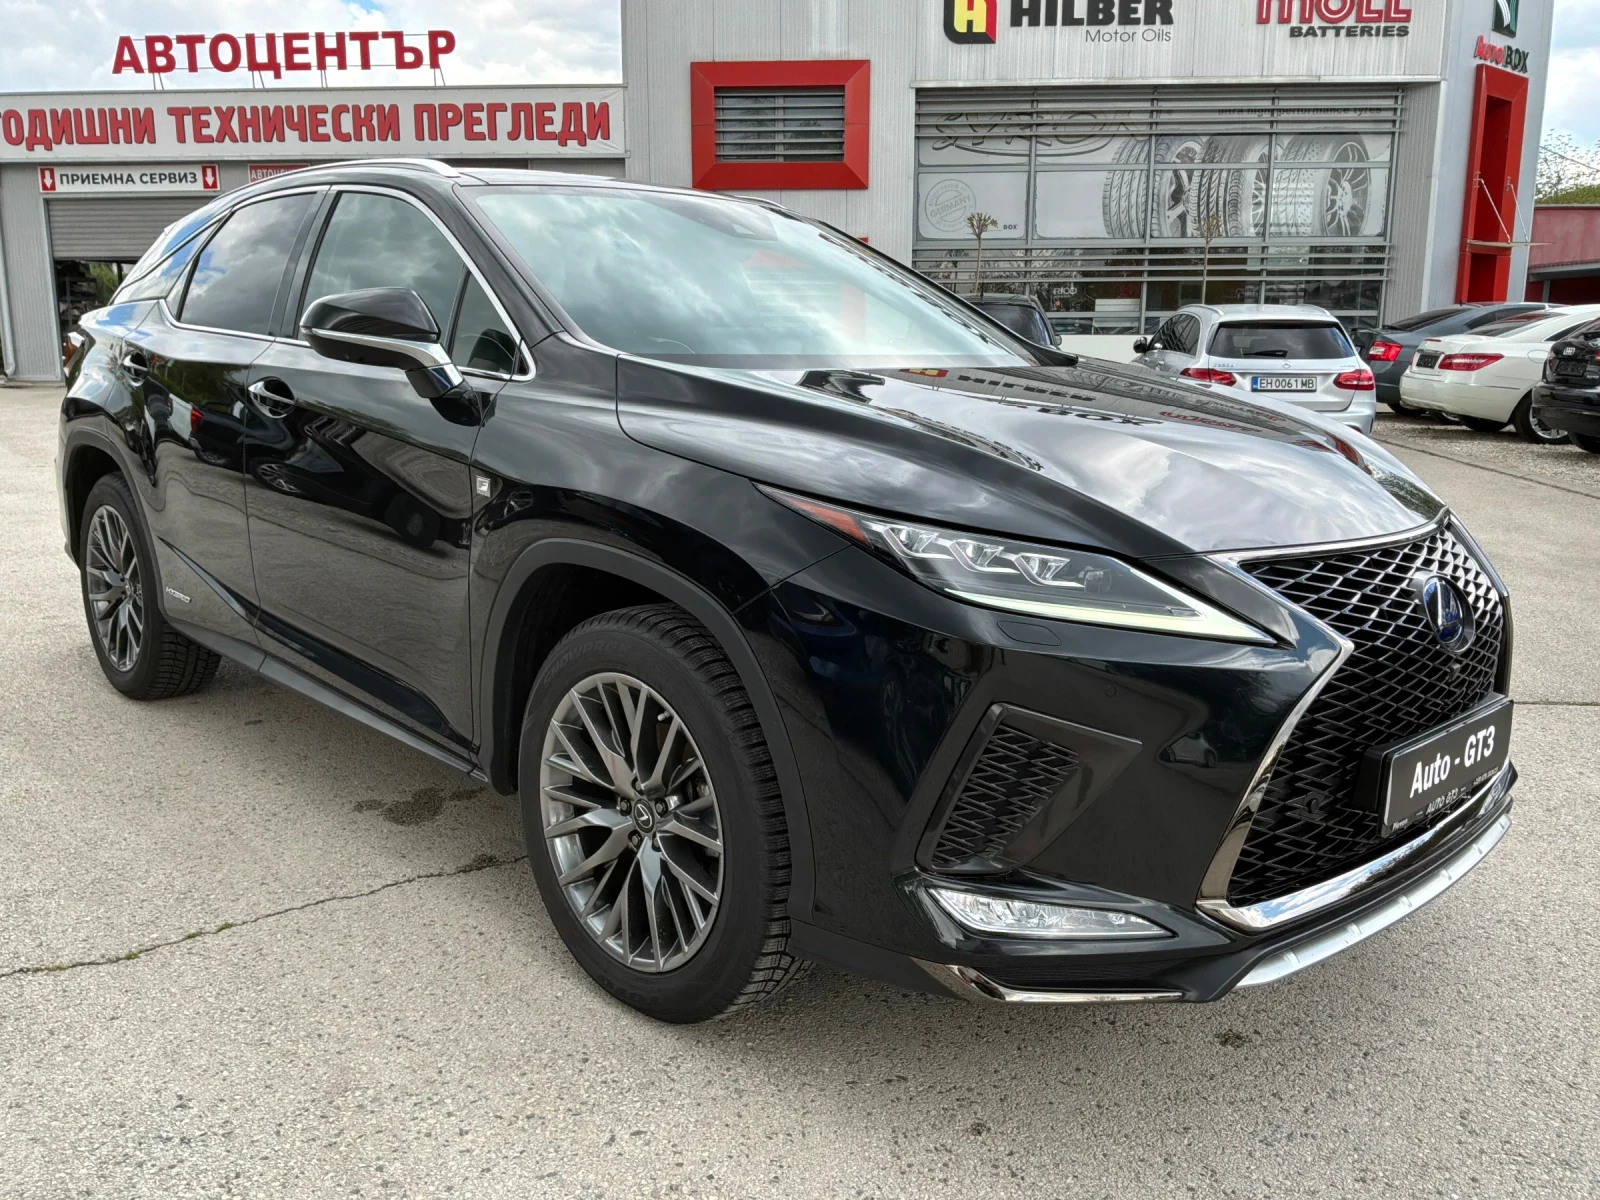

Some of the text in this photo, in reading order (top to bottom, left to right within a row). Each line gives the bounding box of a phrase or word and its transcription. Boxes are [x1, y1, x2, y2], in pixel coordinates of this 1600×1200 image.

[1010, 0, 1174, 27] HILBER
[1085, 28, 1172, 43] Motor Oils
[1289, 25, 1410, 38] BATTERIES
[112, 30, 456, 79] АВТОЦЕНТЪР
[0, 101, 611, 151] ОДИШНИ ТЕХНИЧЕСКИ ПРЕГЛЕДИ
[59, 172, 198, 185] ПРИЕМНА СЕРВИЗ
[930, 194, 971, 217] GERMANY
[1409, 753, 1450, 799] Auto
[1463, 725, 1496, 768] GT3
[1425, 795, 1445, 815] AUTO
